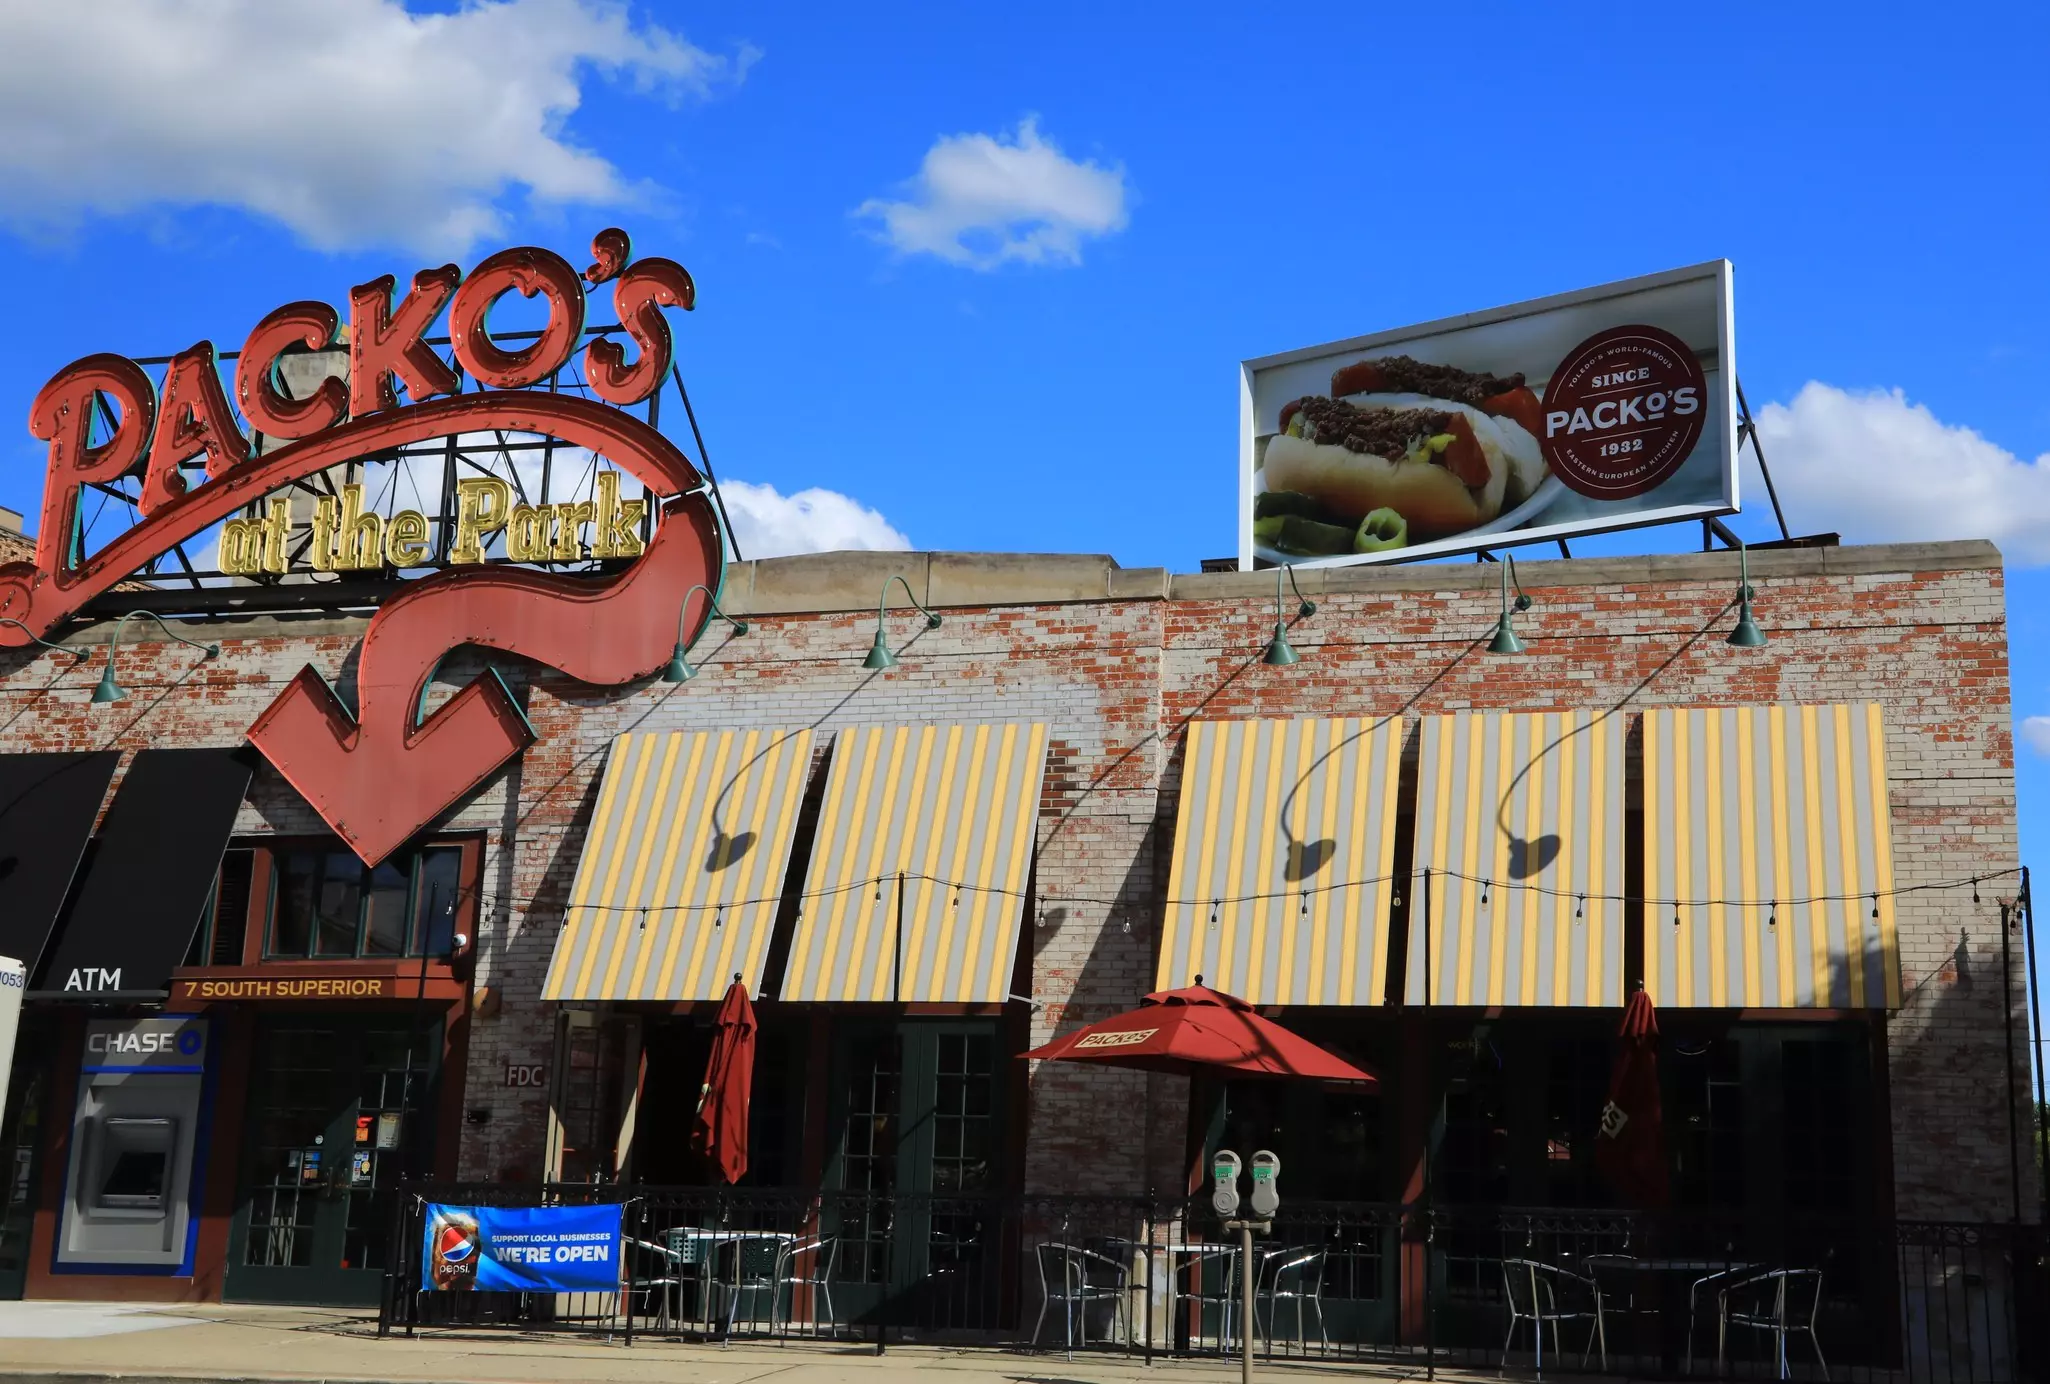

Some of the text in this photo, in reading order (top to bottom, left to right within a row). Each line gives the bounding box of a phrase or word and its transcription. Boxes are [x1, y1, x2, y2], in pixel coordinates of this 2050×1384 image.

[1568, 346, 1673, 388] TOLEDO'S WORLD-FAMOUS
[1591, 367, 1650, 388] SINCE
[29, 227, 696, 590] PACKO'S
[1566, 430, 1679, 479] EASTERN EUROPEAN KITCHEN
[1600, 438, 1643, 457] 1932
[218, 470, 647, 577] at the Park
[0, 971, 23, 988] 053
[64, 968, 122, 991] ATM
[184, 980, 382, 997] 7 SOUTH SUPERIOR
[88, 1032, 174, 1053] CHASE
[507, 1065, 543, 1087] FDC
[491, 1232, 611, 1243] SUPPORT LOCAL BUSINESSES
[493, 1245, 608, 1263] WE'RE OPEN
